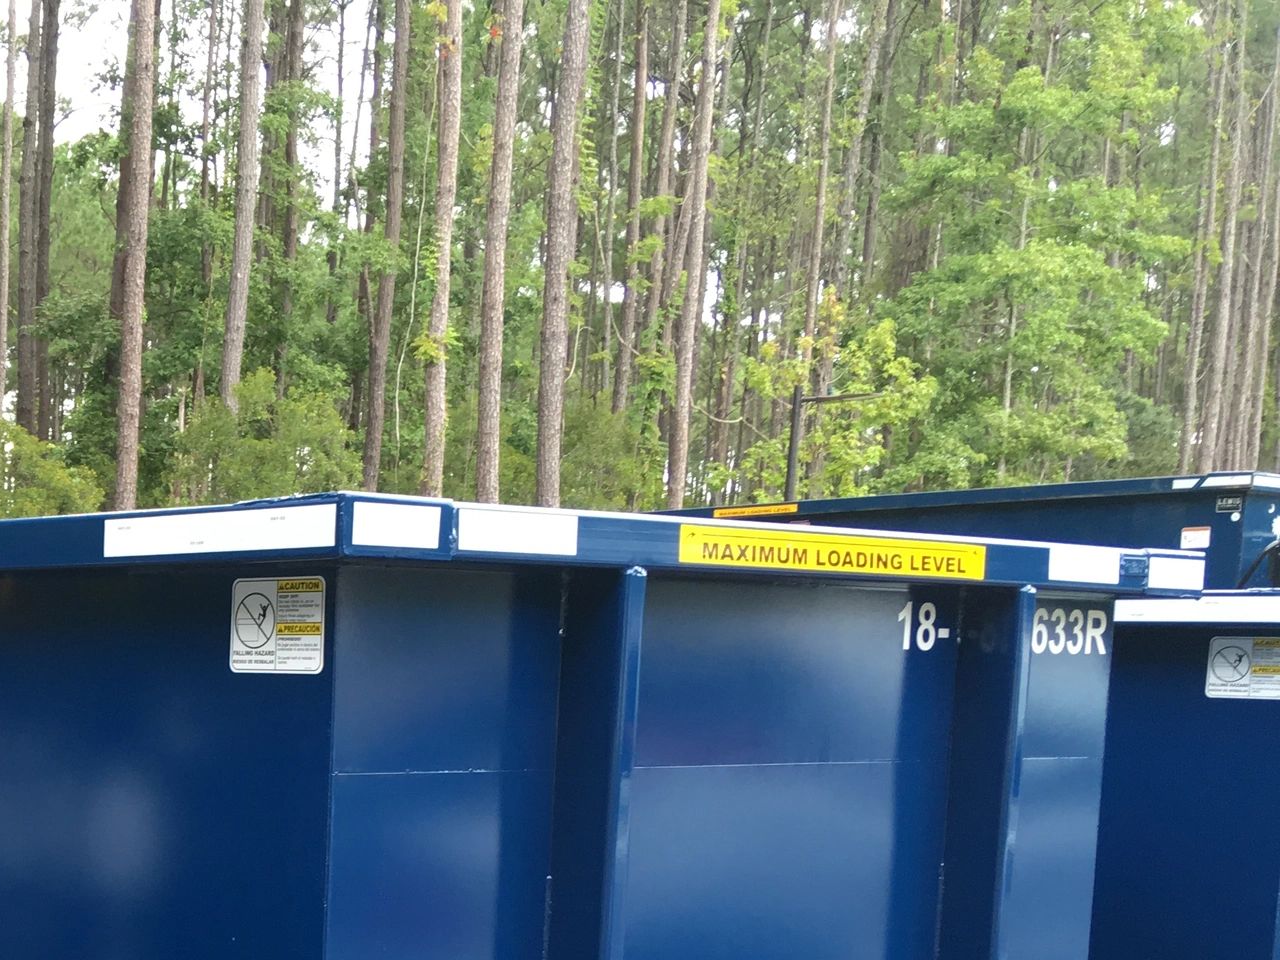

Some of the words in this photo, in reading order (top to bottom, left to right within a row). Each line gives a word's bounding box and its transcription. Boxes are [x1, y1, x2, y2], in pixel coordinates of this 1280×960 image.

[702, 542, 808, 565] MAXIMUM
[816, 549, 903, 570] LOADING
[910, 555, 966, 574] LEVEL
[285, 581, 320, 591] CAUTION
[283, 624, 321, 634] PRECAUCIÓN
[1031, 607, 1107, 655] 633R
